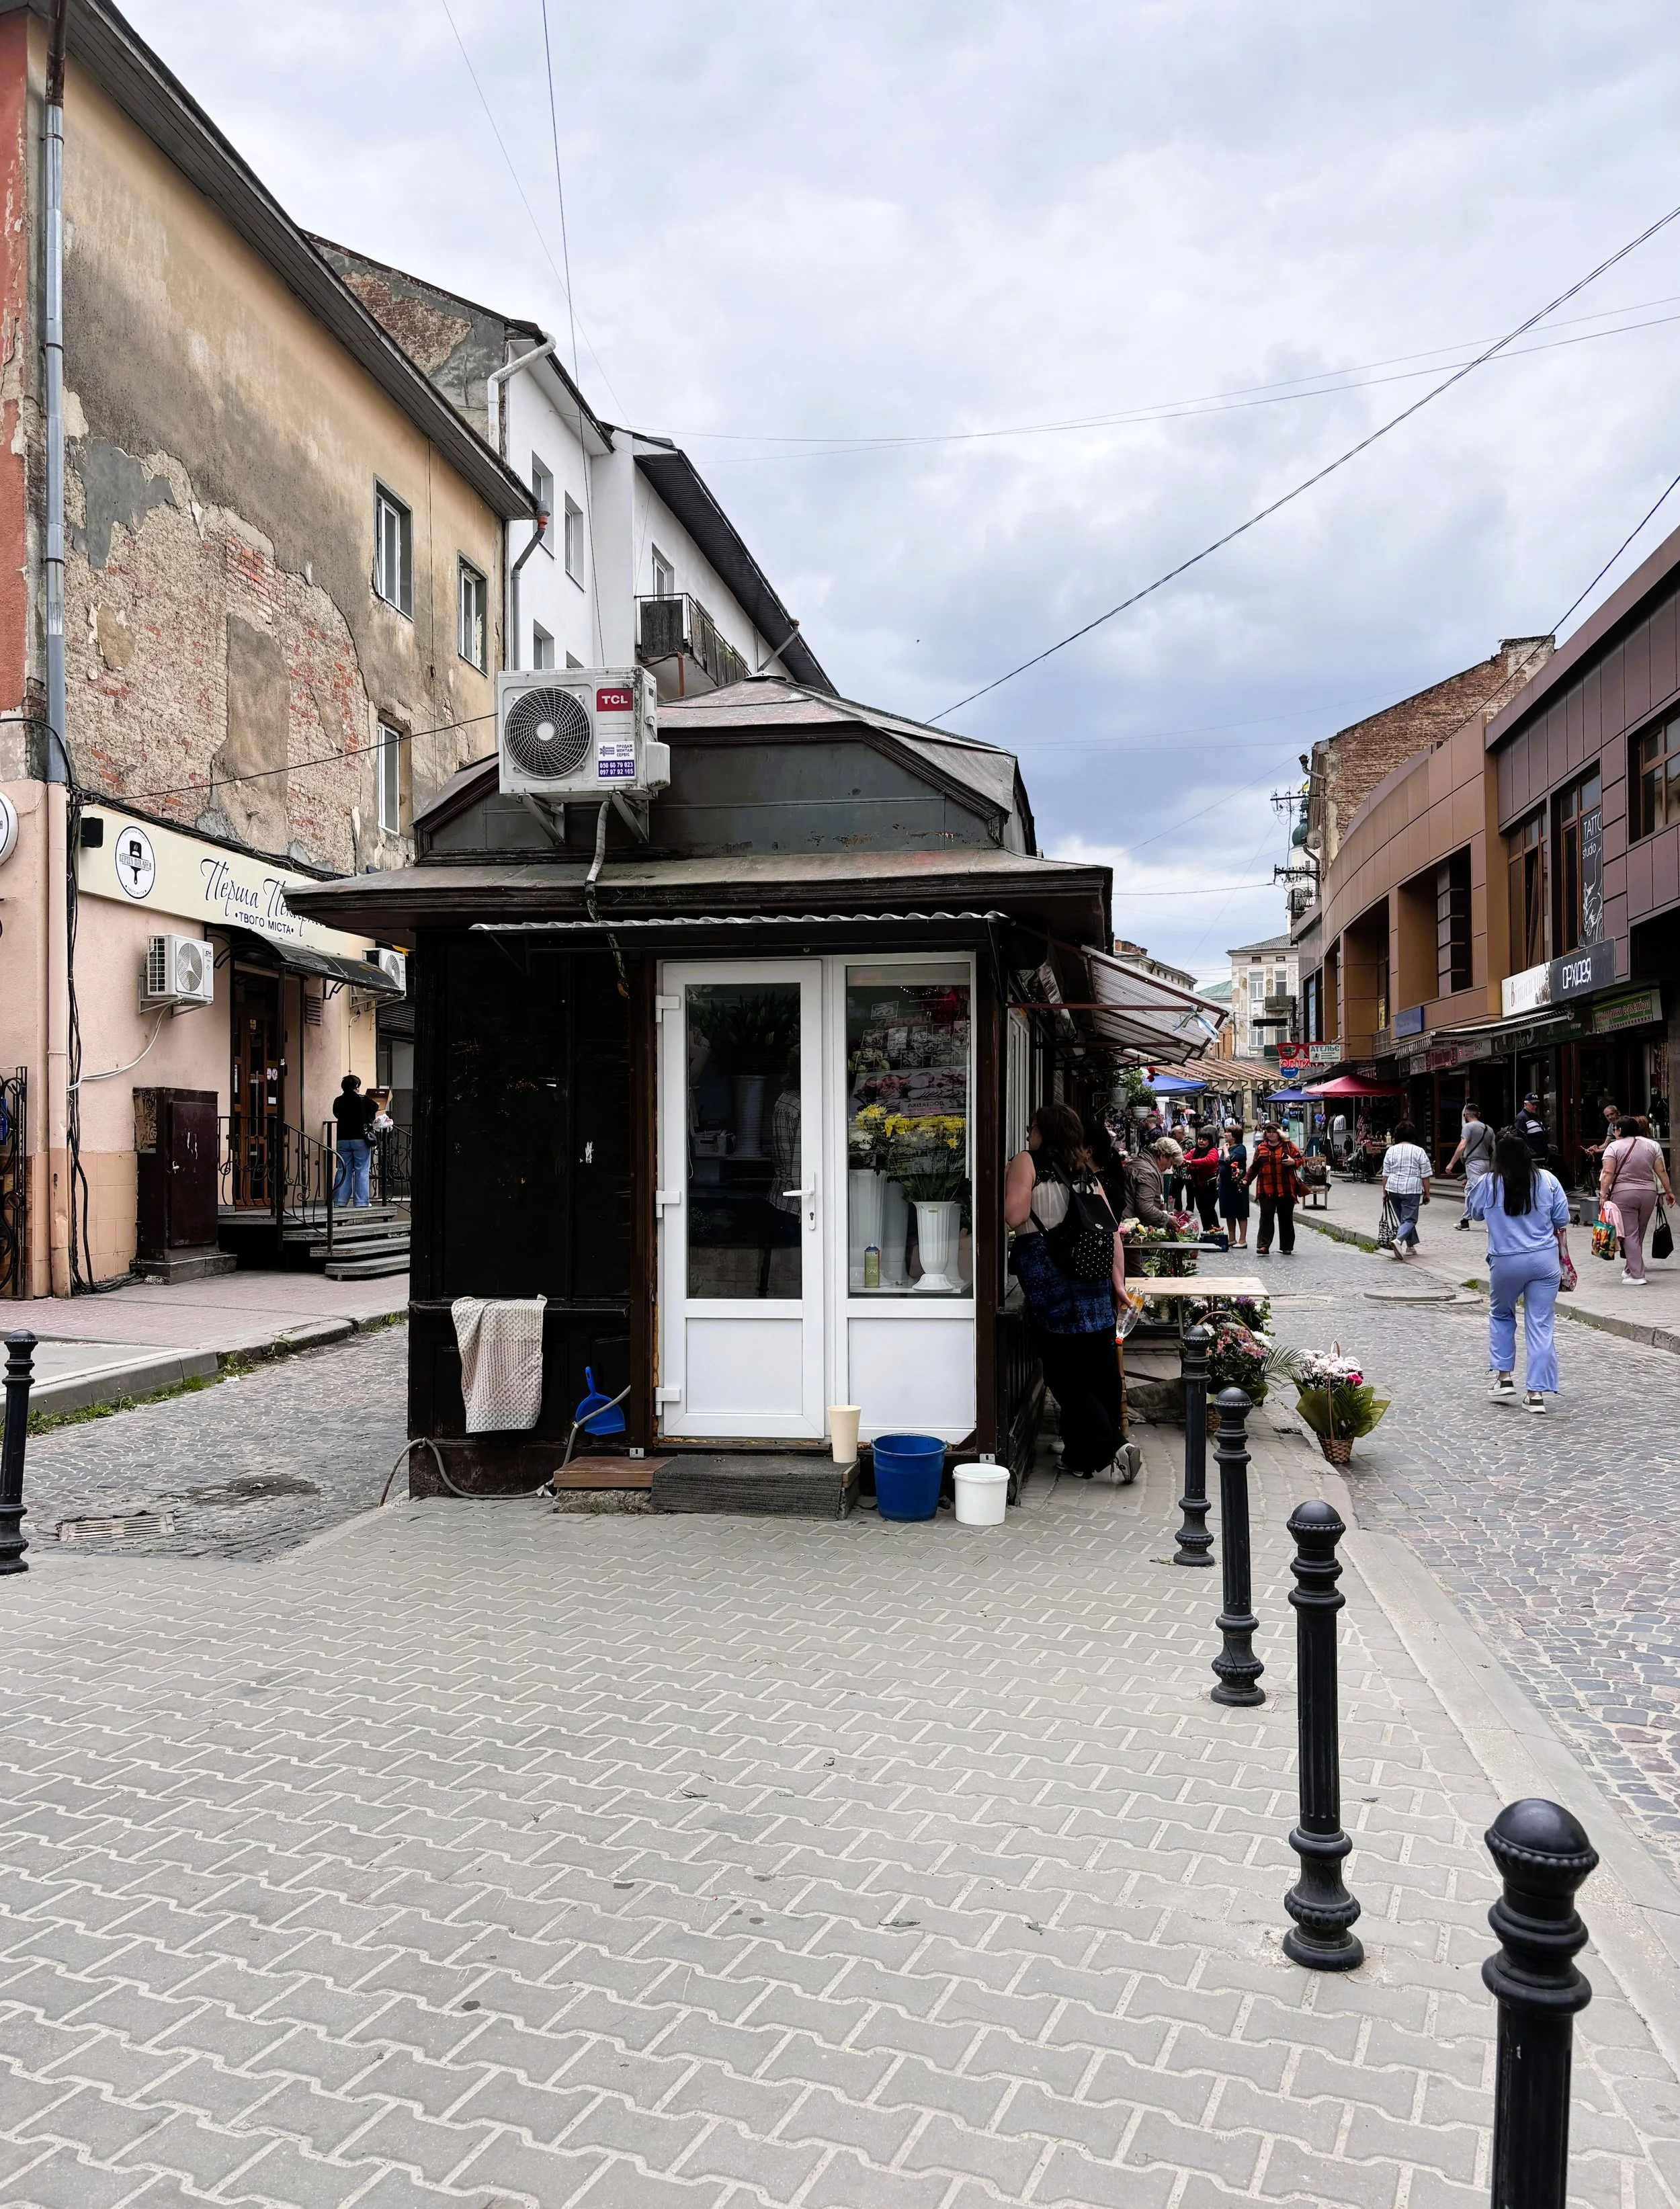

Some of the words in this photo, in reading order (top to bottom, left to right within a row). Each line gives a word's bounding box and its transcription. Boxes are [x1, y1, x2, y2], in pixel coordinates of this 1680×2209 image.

[601, 694, 628, 704] TCL
[200, 858, 259, 917] Перша
[239, 911, 265, 927] ТВОГО
[268, 919, 291, 935] МІСТА
